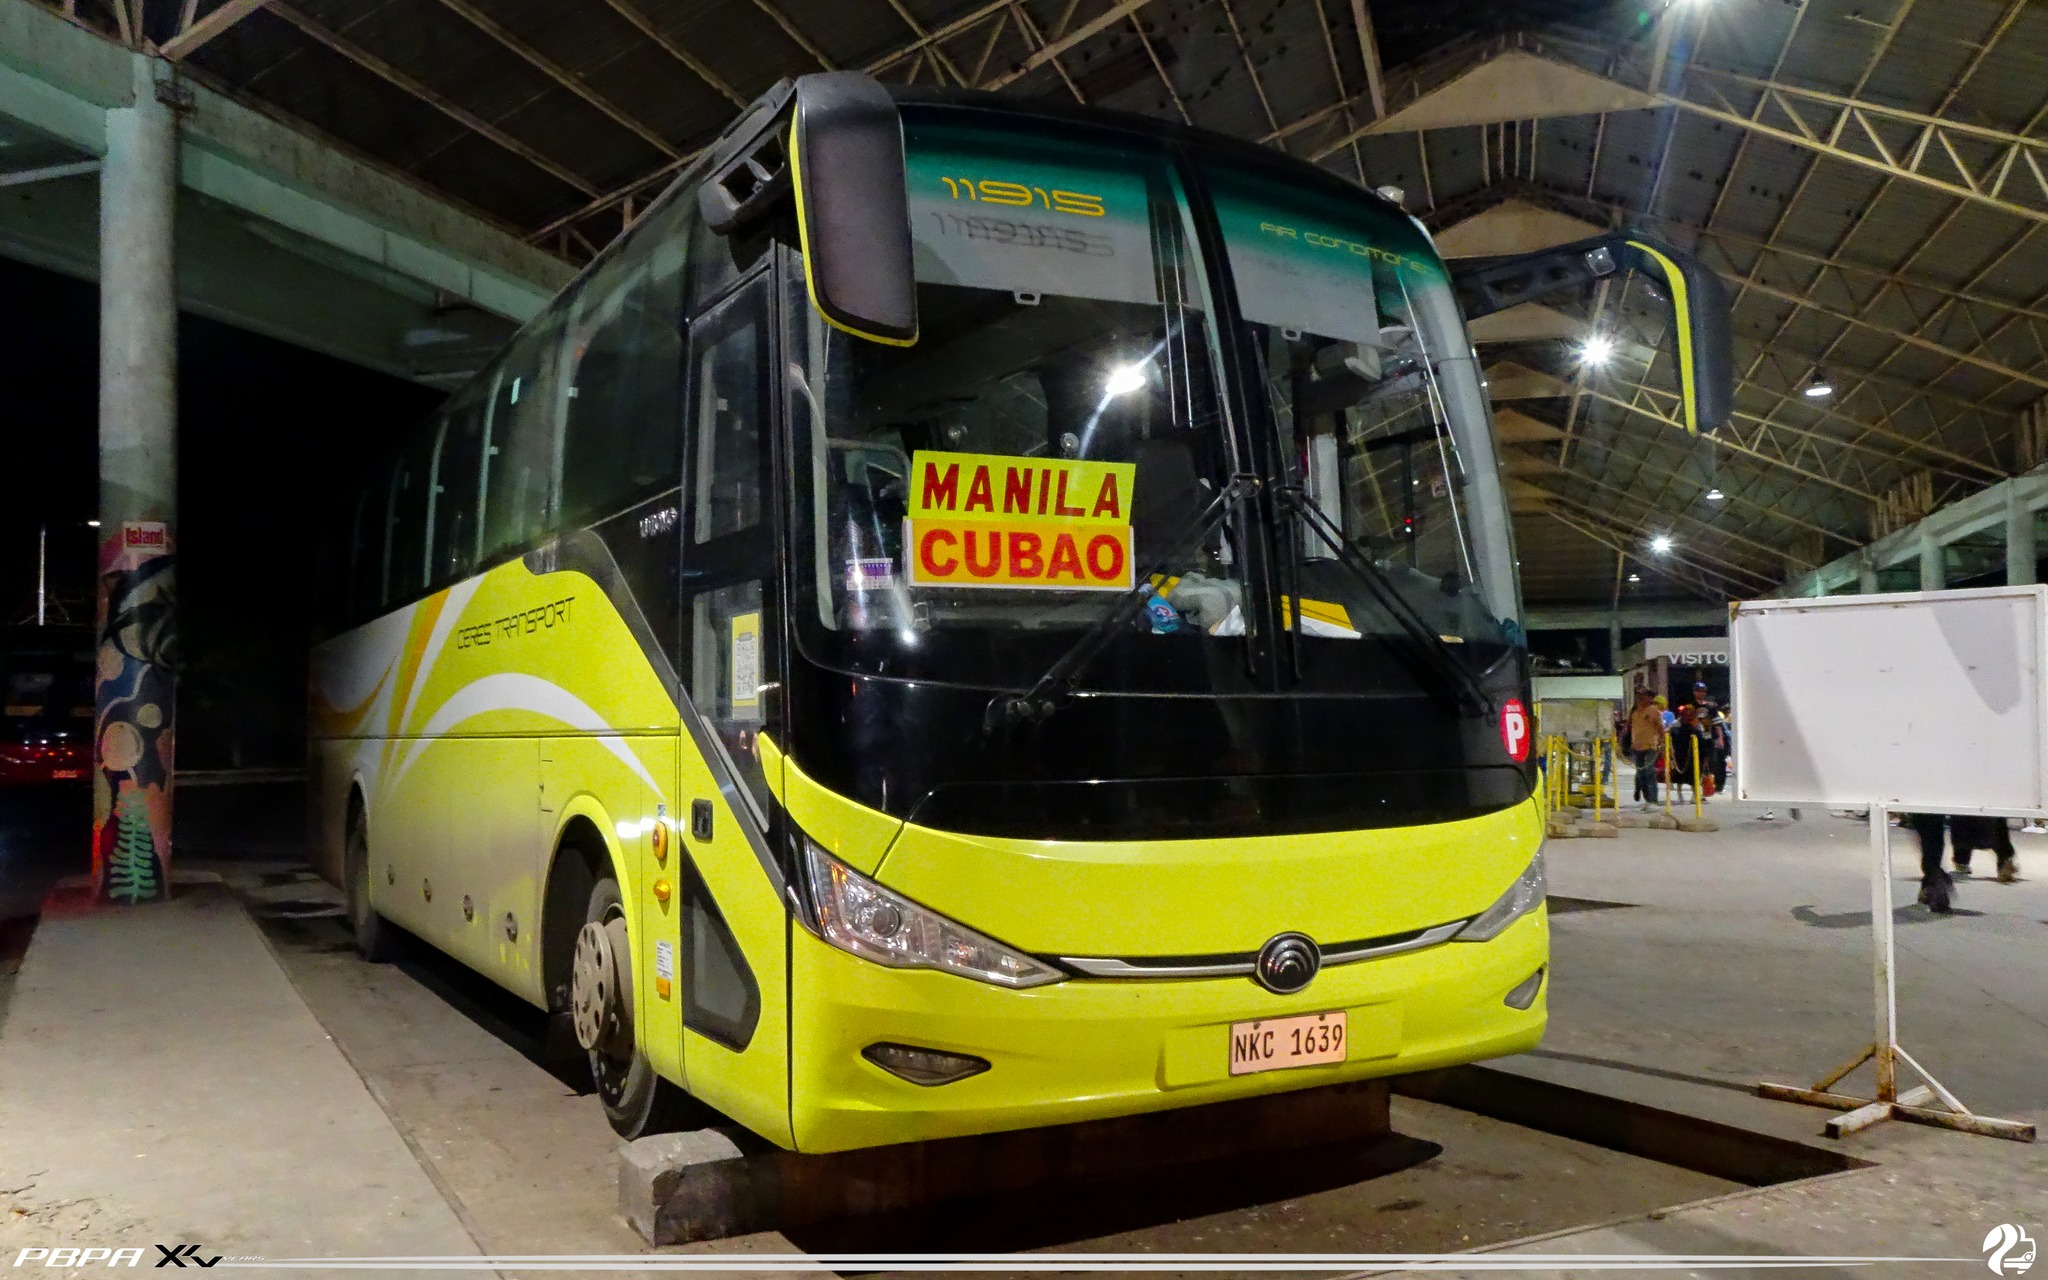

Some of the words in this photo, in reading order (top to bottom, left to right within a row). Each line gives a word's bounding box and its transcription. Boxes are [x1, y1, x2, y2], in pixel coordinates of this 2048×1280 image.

[942, 177, 1105, 217] 11915
[1260, 221, 1298, 240] AIR
[921, 462, 1121, 519] MANILA
[920, 528, 1124, 581] CUBAO
[458, 622, 492, 650] CERES
[495, 596, 576, 639] TRANSPORT
[1505, 712, 1525, 755] P
[1235, 1031, 1274, 1063] NKC
[1290, 1024, 1344, 1056] 1639
